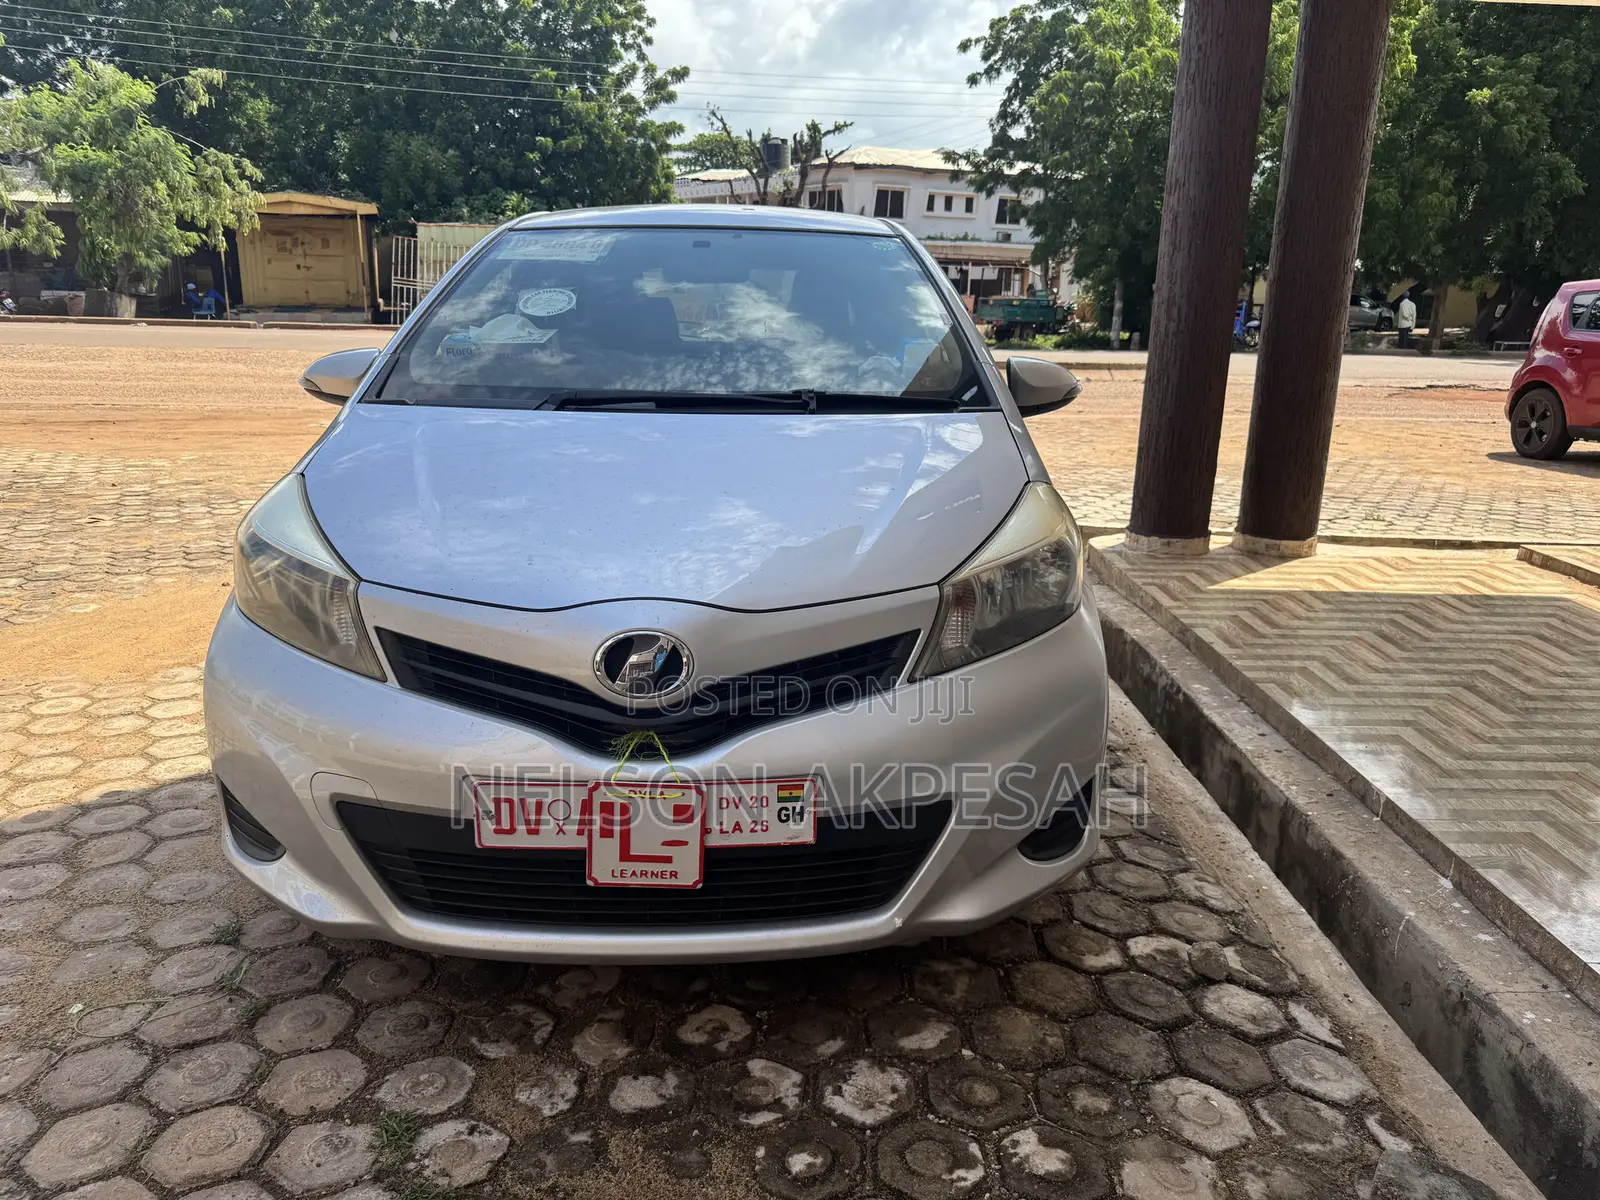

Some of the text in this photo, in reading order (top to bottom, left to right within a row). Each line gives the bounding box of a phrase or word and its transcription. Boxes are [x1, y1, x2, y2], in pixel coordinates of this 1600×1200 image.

[446, 347, 473, 358] Flora
[719, 795, 769, 810] DV 20
[491, 797, 544, 836] DV
[777, 805, 804, 824] GH
[719, 820, 743, 835] LA
[611, 868, 679, 880] LEARNER
